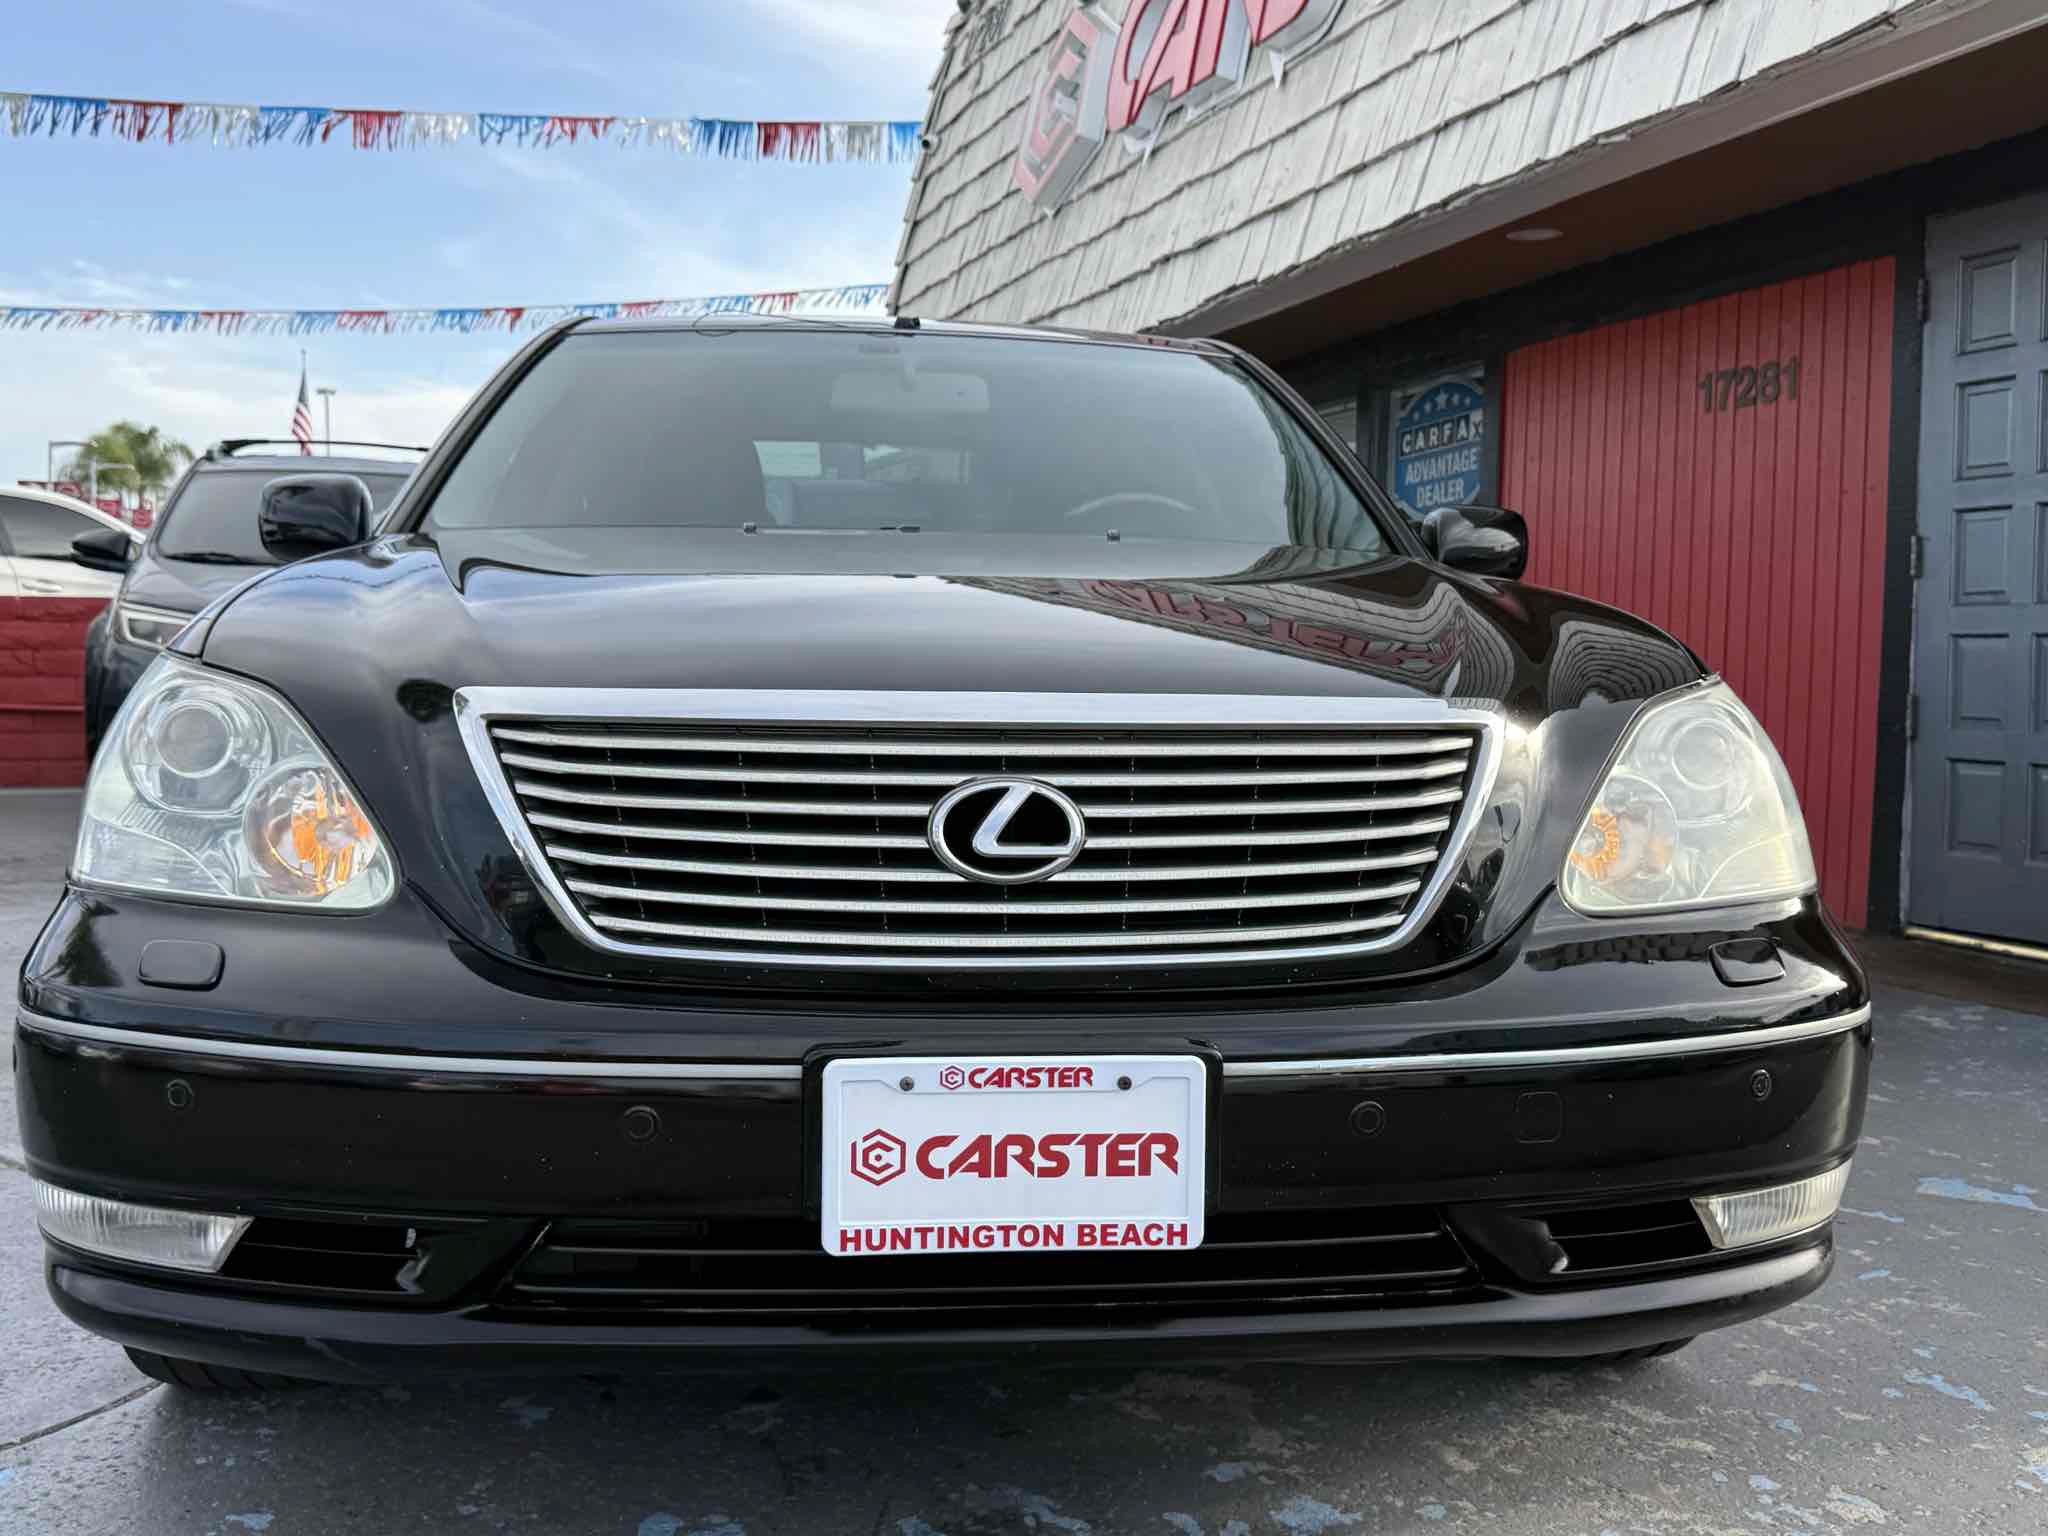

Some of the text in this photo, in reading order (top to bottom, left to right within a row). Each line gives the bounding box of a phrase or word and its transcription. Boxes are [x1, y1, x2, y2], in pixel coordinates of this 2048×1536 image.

[1697, 355, 1801, 413] 17281
[1402, 417, 1484, 453] CARFAX
[1405, 448, 1478, 484] ADVANTAGE
[1416, 478, 1464, 507] DEALER
[968, 1066, 1094, 1088] CARSTER
[916, 1132, 1180, 1179] CARSTER
[840, 1223, 1188, 1251] HUNTINGTON BEACH
